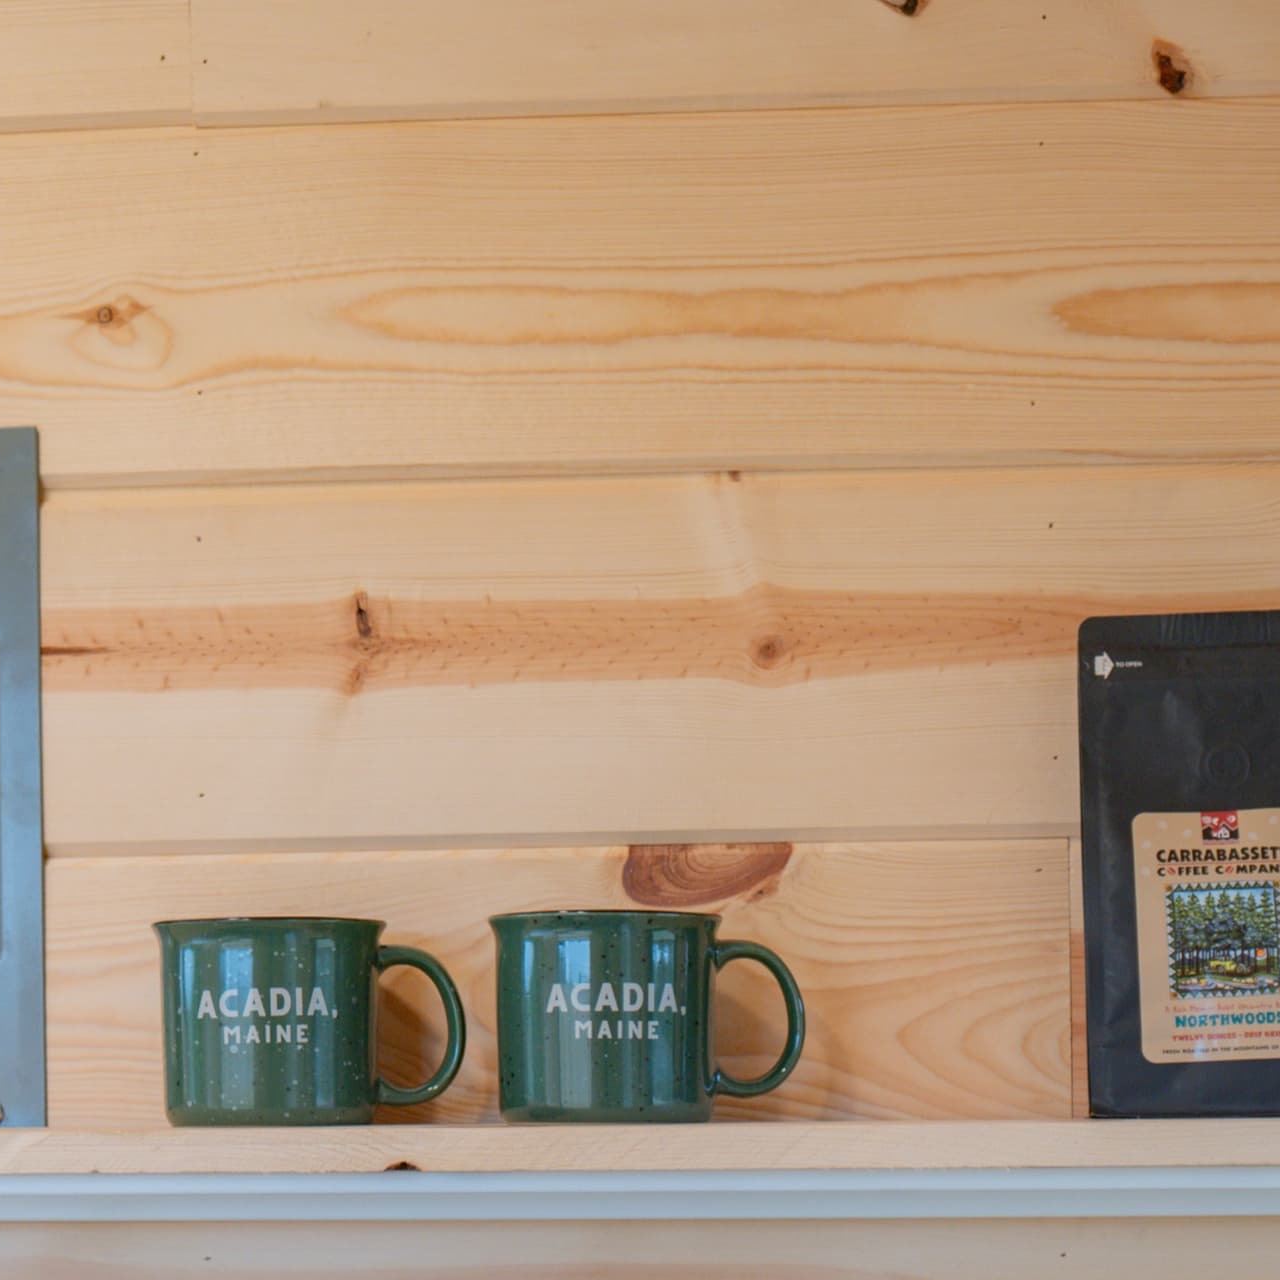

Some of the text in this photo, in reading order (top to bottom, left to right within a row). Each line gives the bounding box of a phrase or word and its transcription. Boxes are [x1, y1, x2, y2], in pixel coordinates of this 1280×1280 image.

[1125, 660, 1143, 668] OPEN
[1157, 865, 1209, 877] COFFEE
[197, 986, 338, 1020] ACADIA,
[545, 982, 687, 1016] ACADIA,
[222, 1022, 309, 1045] MAINE
[574, 1019, 659, 1041] MAINE
[1172, 1033, 1205, 1042] TWELVE
